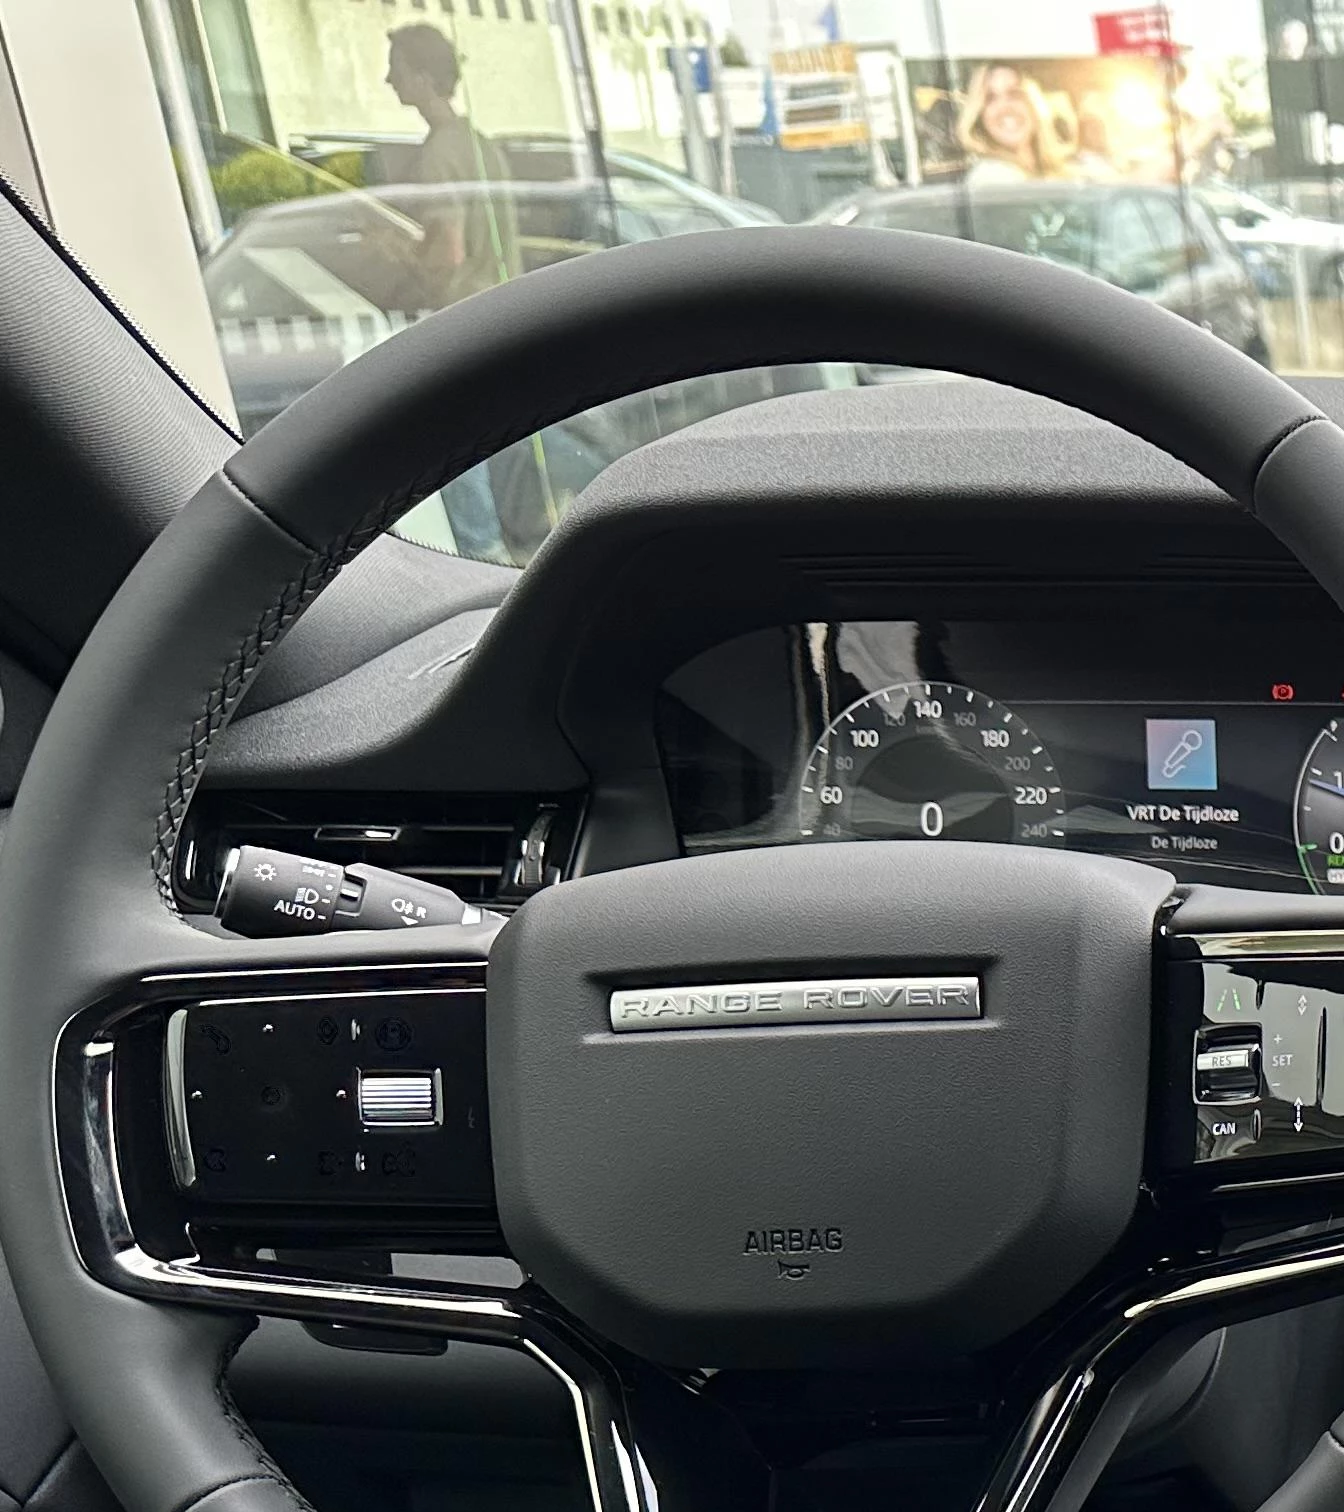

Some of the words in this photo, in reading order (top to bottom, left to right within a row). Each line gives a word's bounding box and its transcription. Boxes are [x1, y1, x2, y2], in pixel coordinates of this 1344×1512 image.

[914, 700, 942, 718] 140
[953, 711, 977, 727] 160
[850, 729, 880, 748] 100
[980, 729, 1010, 748] 180
[835, 756, 854, 771] 80
[1005, 755, 1031, 771] 200
[1333, 771, 1343, 788] 1
[820, 786, 843, 804] 60
[1014, 786, 1048, 806] 220
[920, 801, 944, 837] 0
[1126, 804, 1157, 822] VRT
[1159, 804, 1180, 822] De
[1182, 804, 1240, 824] Tijdloze
[1021, 823, 1048, 838] 240
[1151, 835, 1170, 850] De
[1172, 835, 1218, 851] Tijdloze
[1329, 831, 1344, 854] 0
[274, 899, 316, 921] AUTO
[619, 990, 784, 1019] RANGE
[802, 983, 971, 1010] ROVER
[1211, 1055, 1232, 1067] RES
[1271, 1054, 1294, 1067] SET
[1212, 1122, 1236, 1135] CAN
[743, 1228, 844, 1255] AIRBAG
